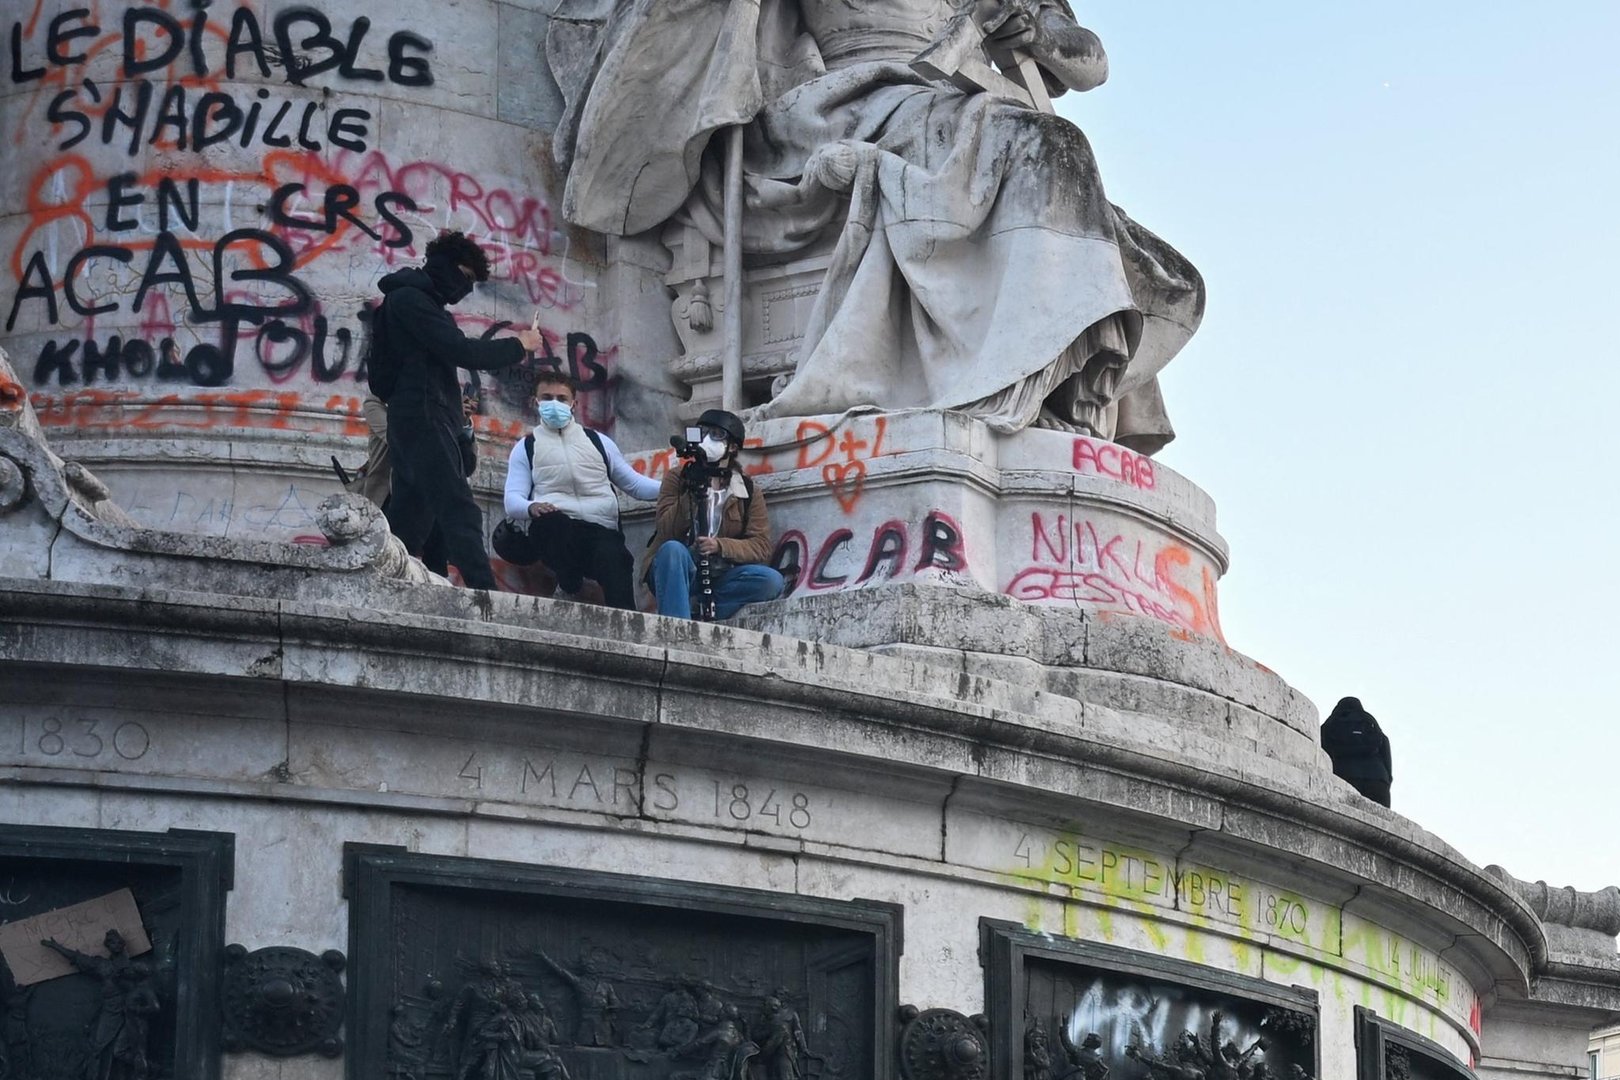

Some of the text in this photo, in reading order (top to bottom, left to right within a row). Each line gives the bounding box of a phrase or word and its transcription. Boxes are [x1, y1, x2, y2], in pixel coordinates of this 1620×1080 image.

[11, 8, 100, 84] LE
[106, 172, 200, 233] EN
[269, 182, 418, 249] CRS
[5, 228, 314, 332] ACAB
[1072, 438, 1155, 490] ACAB
[772, 510, 967, 598] ACAB
[1031, 511, 1130, 583] NIK
[16, 715, 152, 762] 1830
[456, 750, 813, 830] 4 MARS 1848
[1012, 832, 1307, 935] 4 SEPTEMBRE 1870
[1387, 937, 1400, 973] 14
